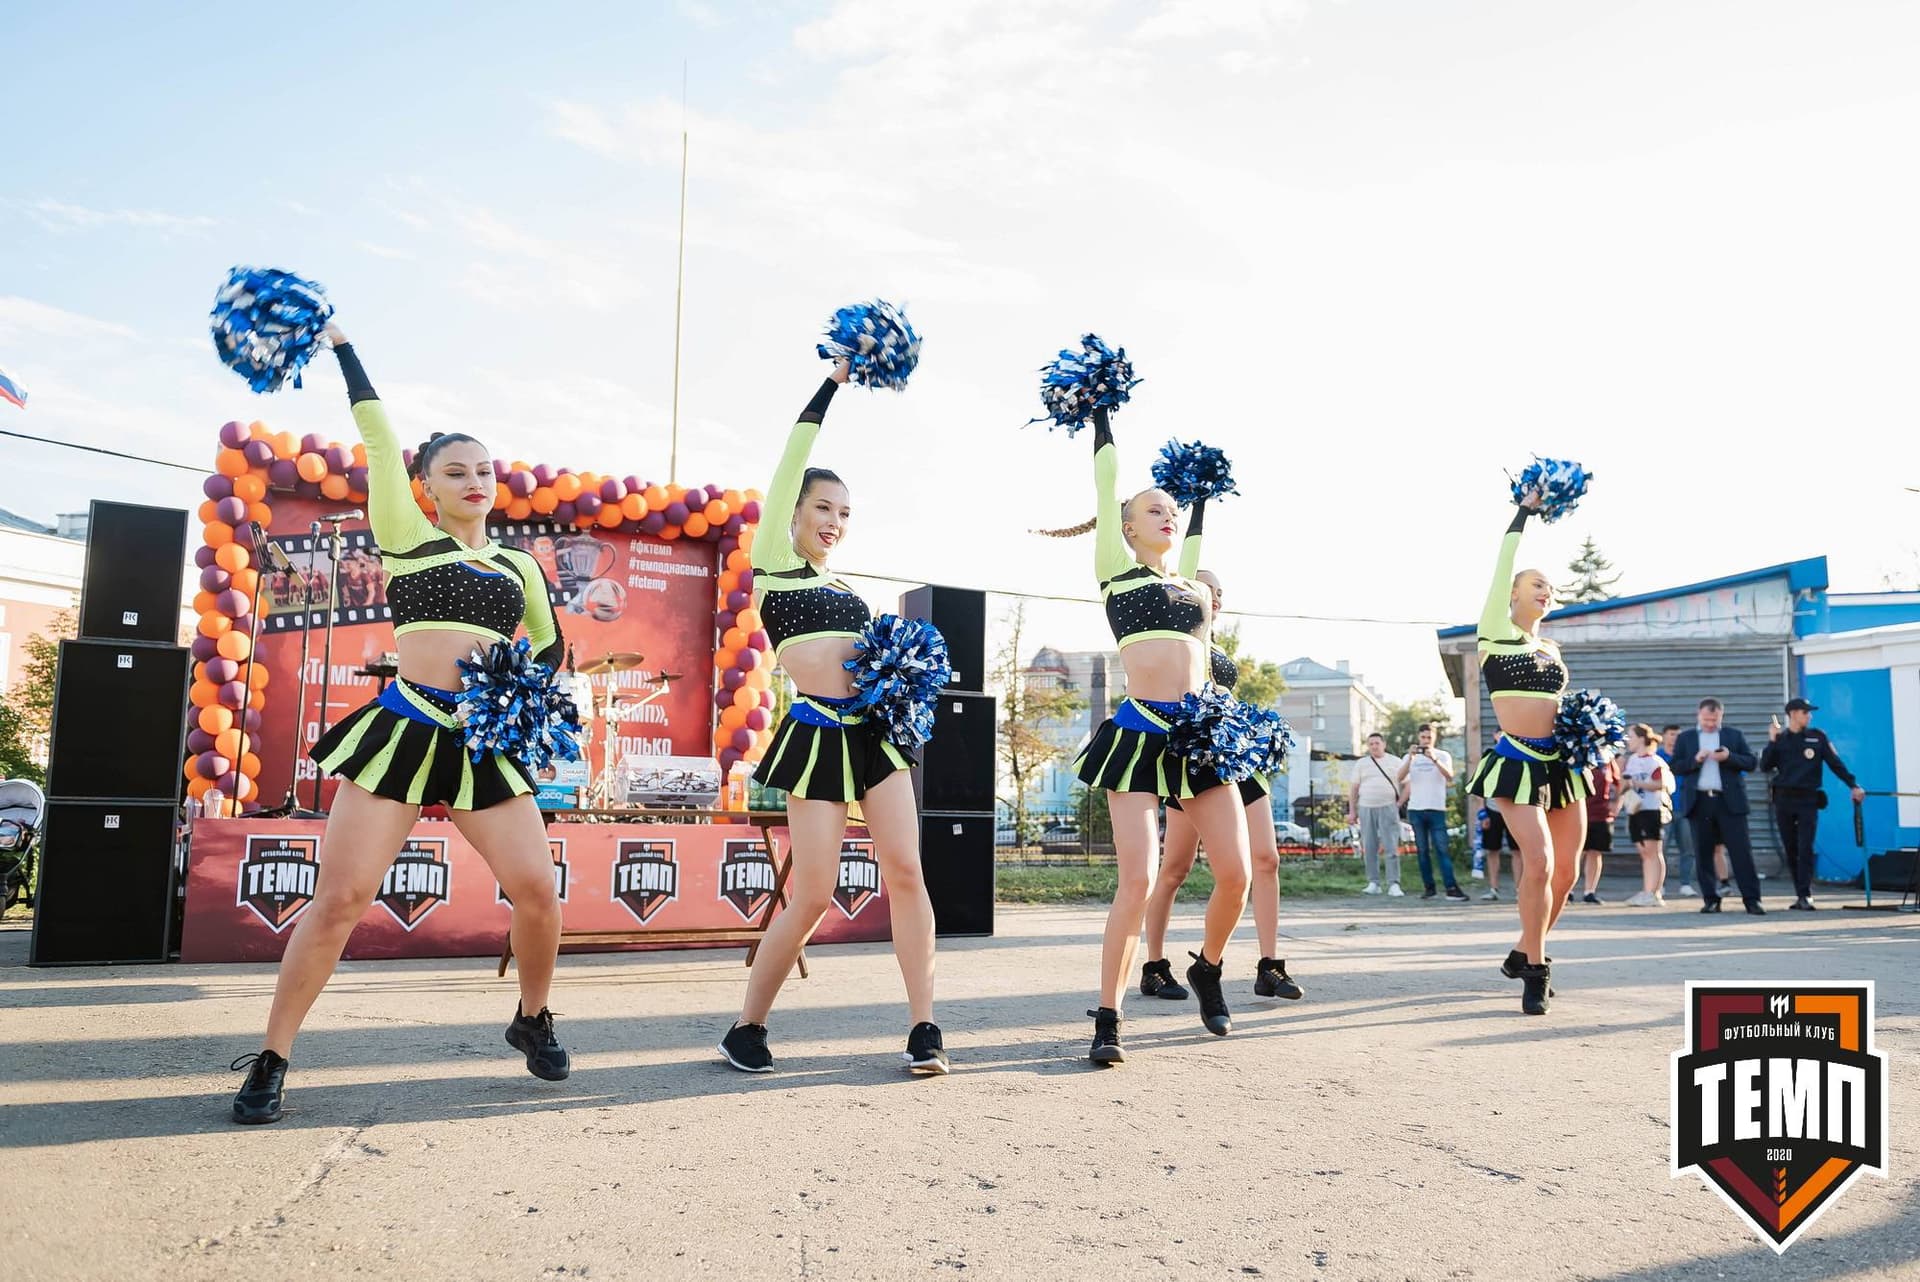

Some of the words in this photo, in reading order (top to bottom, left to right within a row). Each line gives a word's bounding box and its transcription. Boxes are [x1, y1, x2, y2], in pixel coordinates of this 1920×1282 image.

[629, 539, 672, 556] #фктемп
[628, 574, 667, 592] #fctemp
[248, 862, 315, 896] ТЕМП
[383, 862, 444, 896] ТЕМП
[619, 862, 673, 893] ТЕМП
[725, 862, 775, 892] ТЕМП
[840, 861, 876, 889] ЕМП
